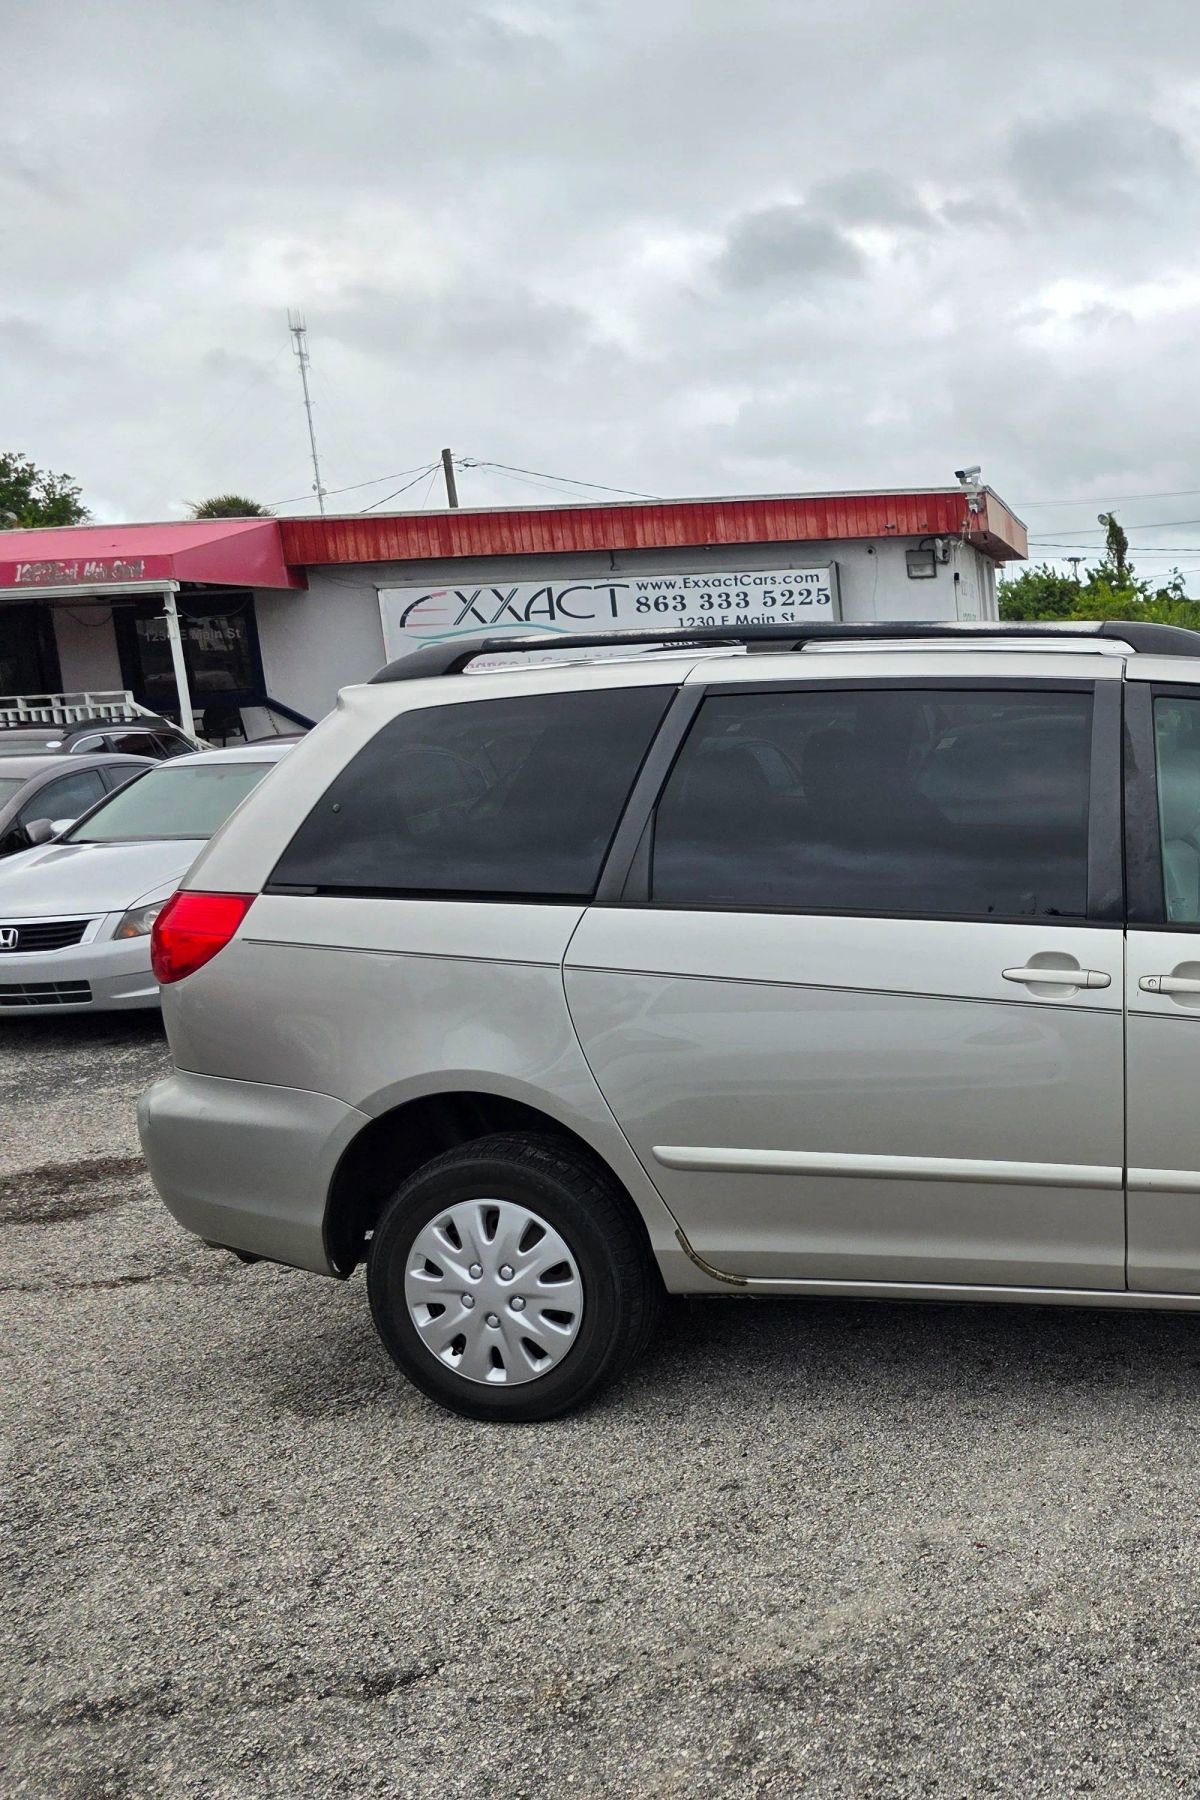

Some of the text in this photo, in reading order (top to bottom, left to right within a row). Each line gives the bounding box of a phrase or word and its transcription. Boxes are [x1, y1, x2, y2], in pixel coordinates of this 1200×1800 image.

[636, 573, 820, 591] www.ExxactCars.com
[400, 584, 630, 628] EXXACT
[635, 587, 831, 613] 863 333 5225
[736, 612, 775, 625] Main
[781, 612, 795, 622] St
[143, 632, 169, 642] 123
[190, 628, 223, 640] Main
[226, 627, 241, 639] St
